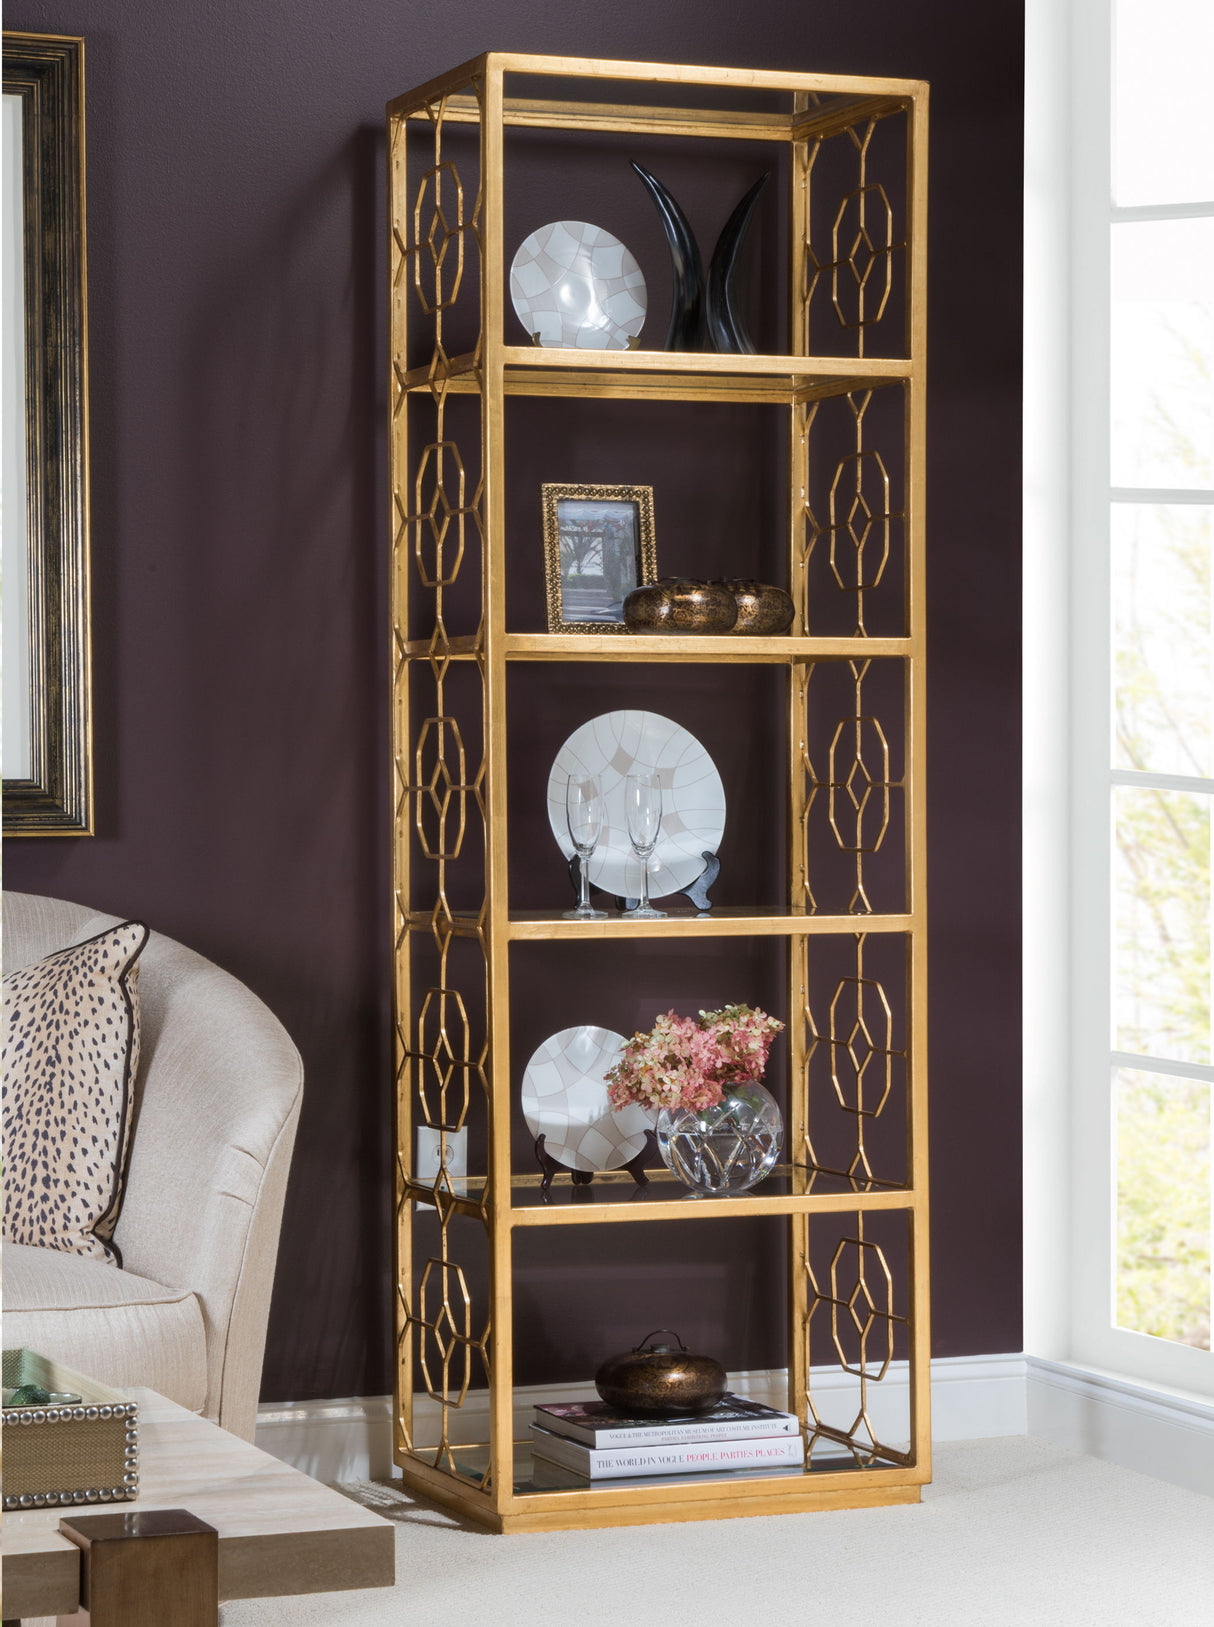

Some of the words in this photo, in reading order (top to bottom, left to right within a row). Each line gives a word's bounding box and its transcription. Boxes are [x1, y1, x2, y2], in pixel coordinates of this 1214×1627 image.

[597, 1459, 614, 1469] THE
[615, 1457, 646, 1467] WORLD
[647, 1457, 656, 1465] IN
[658, 1455, 685, 1464] VOGUE
[686, 1452, 718, 1463] PEOPLE
[720, 1449, 753, 1460] PARTIES
[755, 1447, 785, 1458] PLACES
